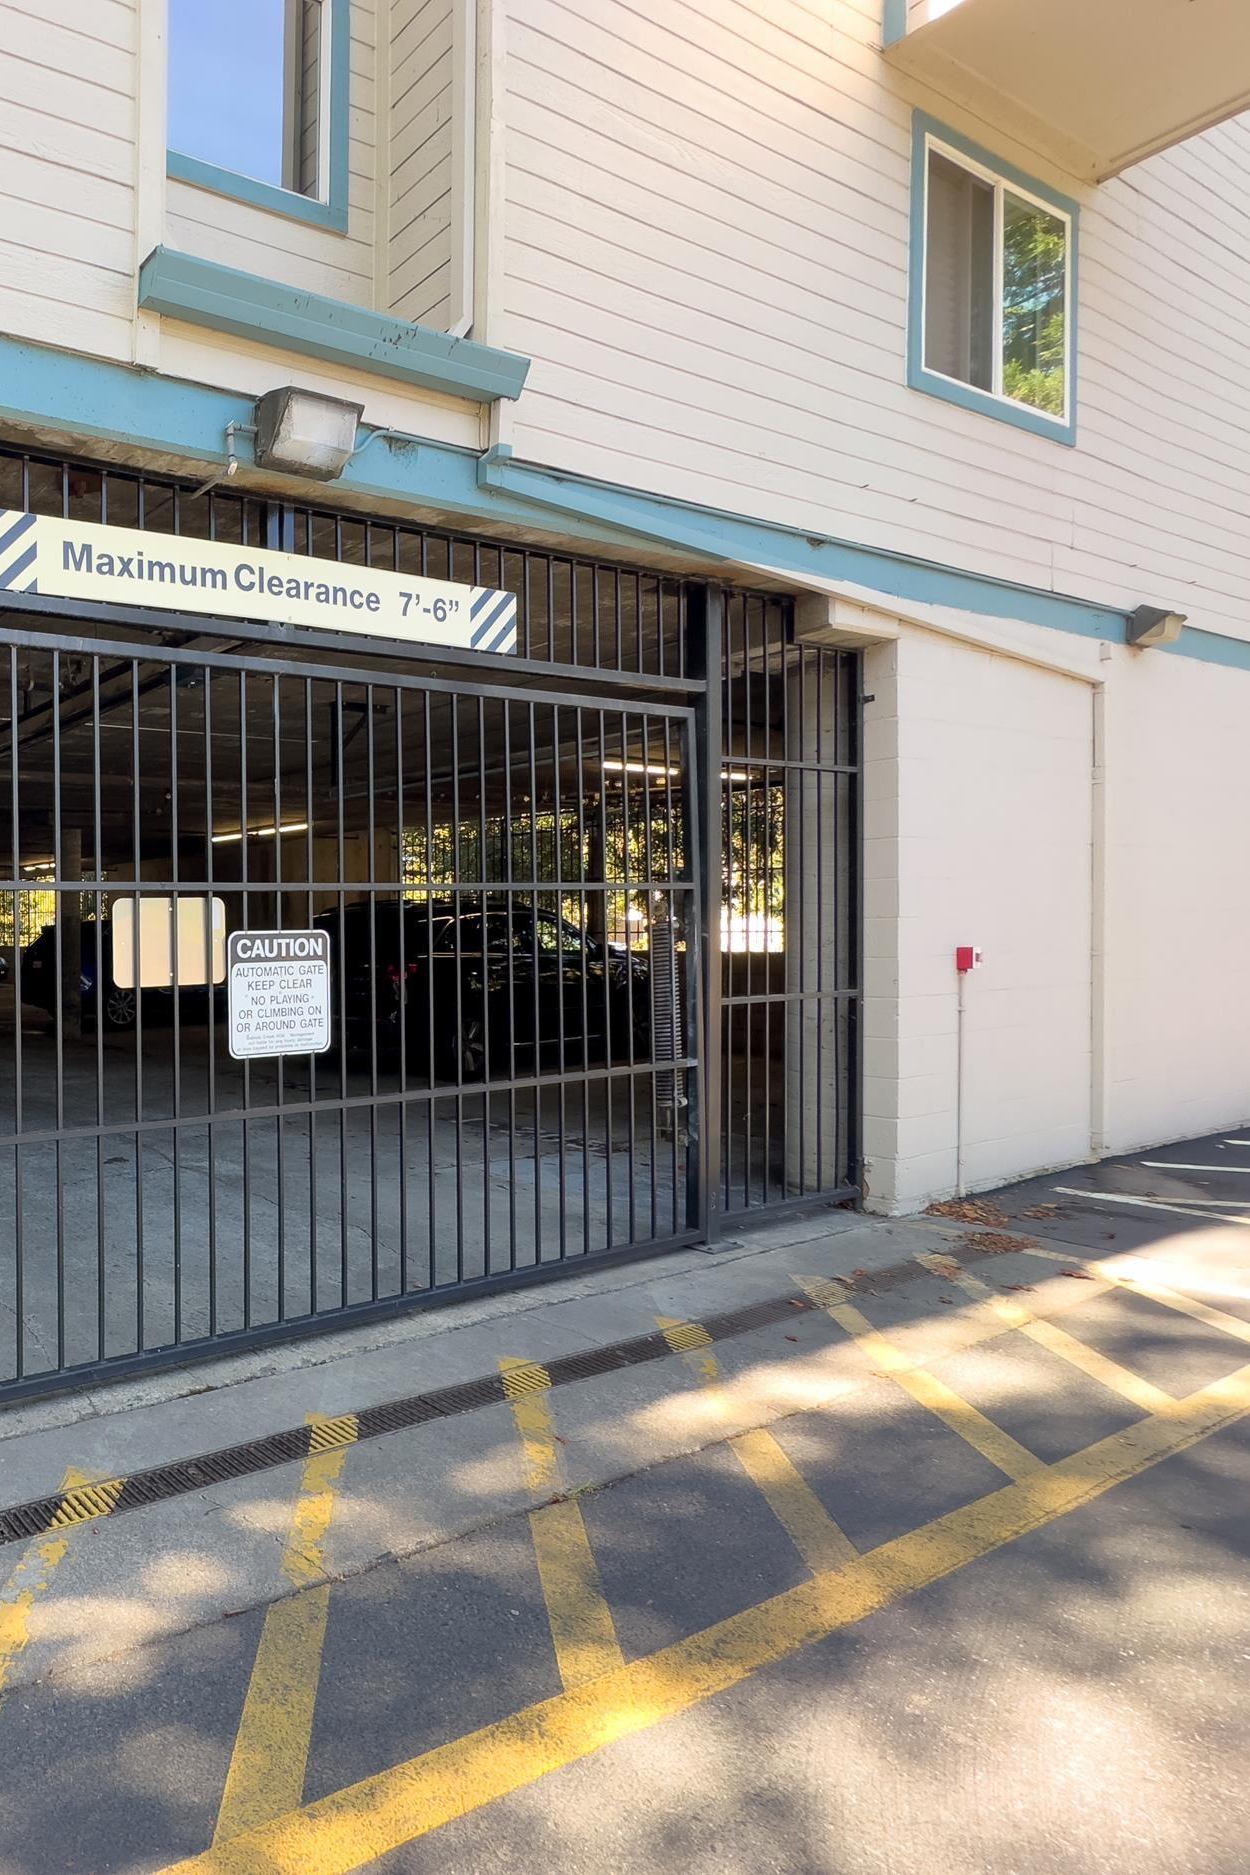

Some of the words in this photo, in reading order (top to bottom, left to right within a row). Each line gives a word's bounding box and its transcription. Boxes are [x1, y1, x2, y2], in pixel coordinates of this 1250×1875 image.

[62, 540, 228, 590] Maximum
[234, 563, 380, 612] Clearance
[236, 938, 323, 958] CAUTION
[235, 966, 294, 978] AUTOMATIC
[299, 965, 324, 975] GATE
[248, 980, 274, 991] KEEP
[279, 979, 312, 989] CLEAR
[251, 996, 265, 1006] NO
[270, 994, 309, 1005] PLAYING
[239, 1010, 252, 1019] OR
[258, 1007, 304, 1019] CLIMBING
[308, 1006, 322, 1015] ON
[237, 1023, 250, 1033] OR
[255, 1020, 296, 1031] AROUND
[300, 1018, 323, 1028] GATE
